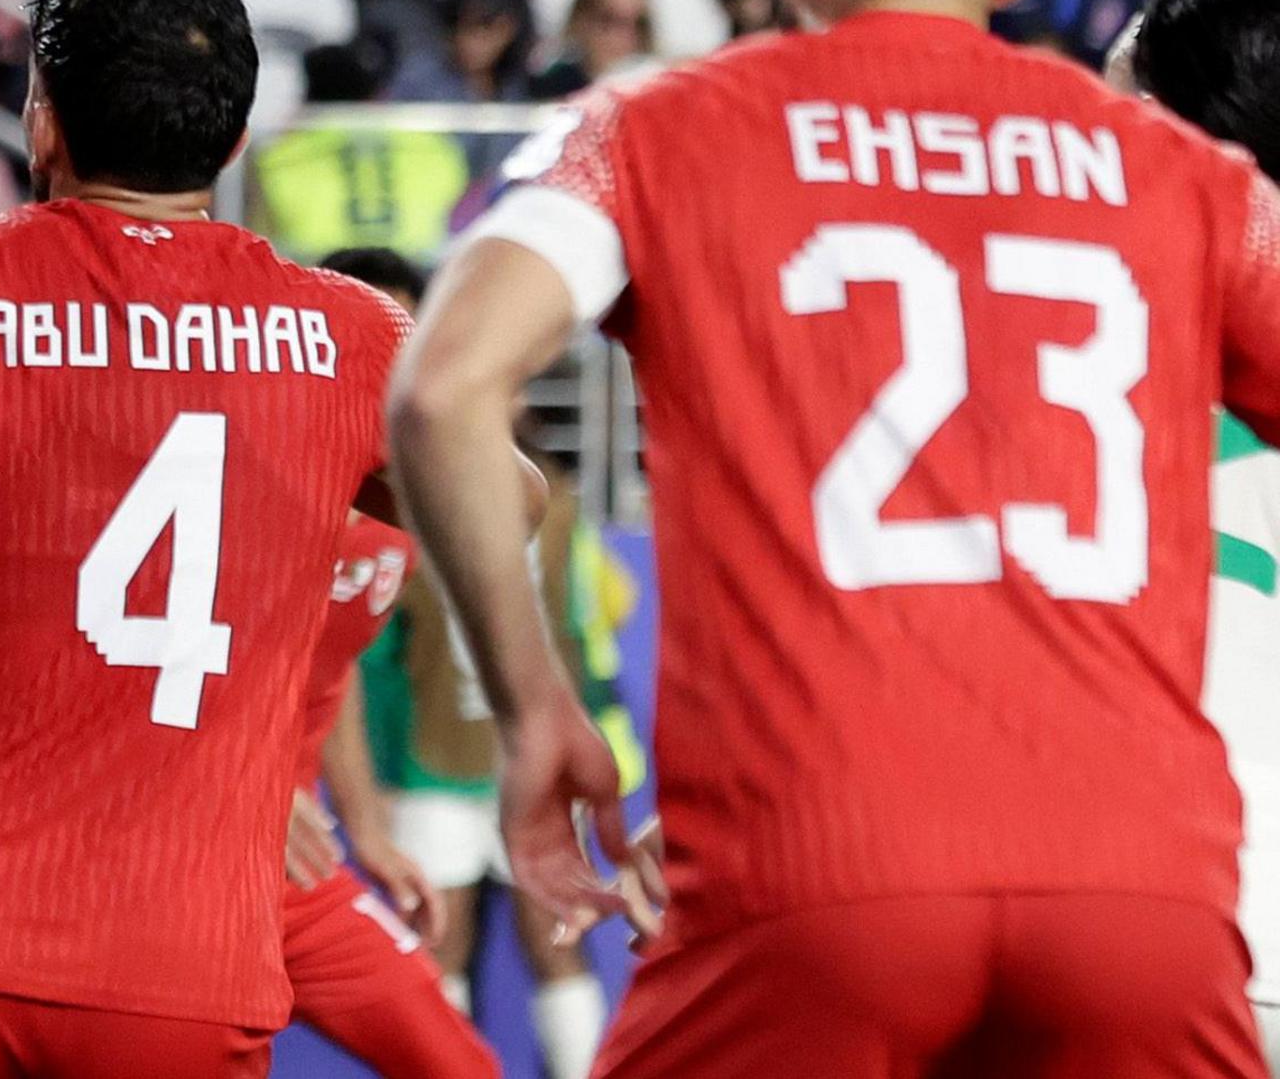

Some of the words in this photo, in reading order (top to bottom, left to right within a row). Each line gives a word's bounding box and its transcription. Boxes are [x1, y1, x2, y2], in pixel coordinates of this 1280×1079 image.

[784, 100, 1128, 208] EHSAN
[126, 303, 339, 380] DAHAB
[779, 222, 1150, 606] 23
[76, 411, 232, 731] 4
